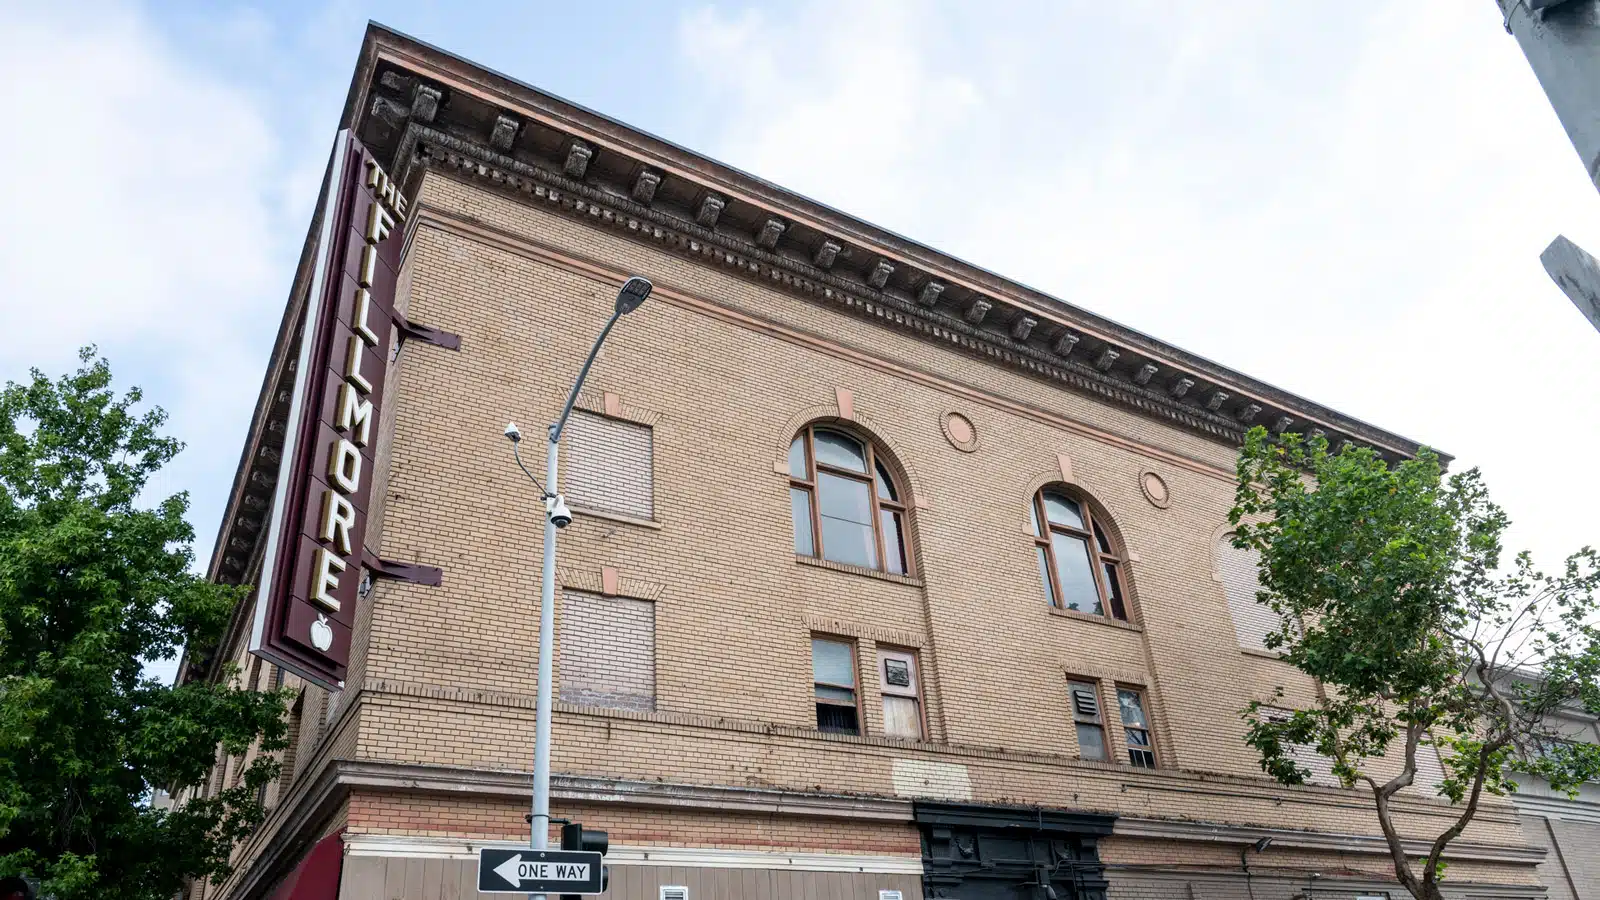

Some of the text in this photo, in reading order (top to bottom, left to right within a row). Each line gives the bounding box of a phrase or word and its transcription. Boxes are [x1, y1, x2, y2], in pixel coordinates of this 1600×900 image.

[366, 158, 408, 222] THE
[310, 202, 395, 613] FILLMORE
[518, 863, 587, 879] ONE WAY
